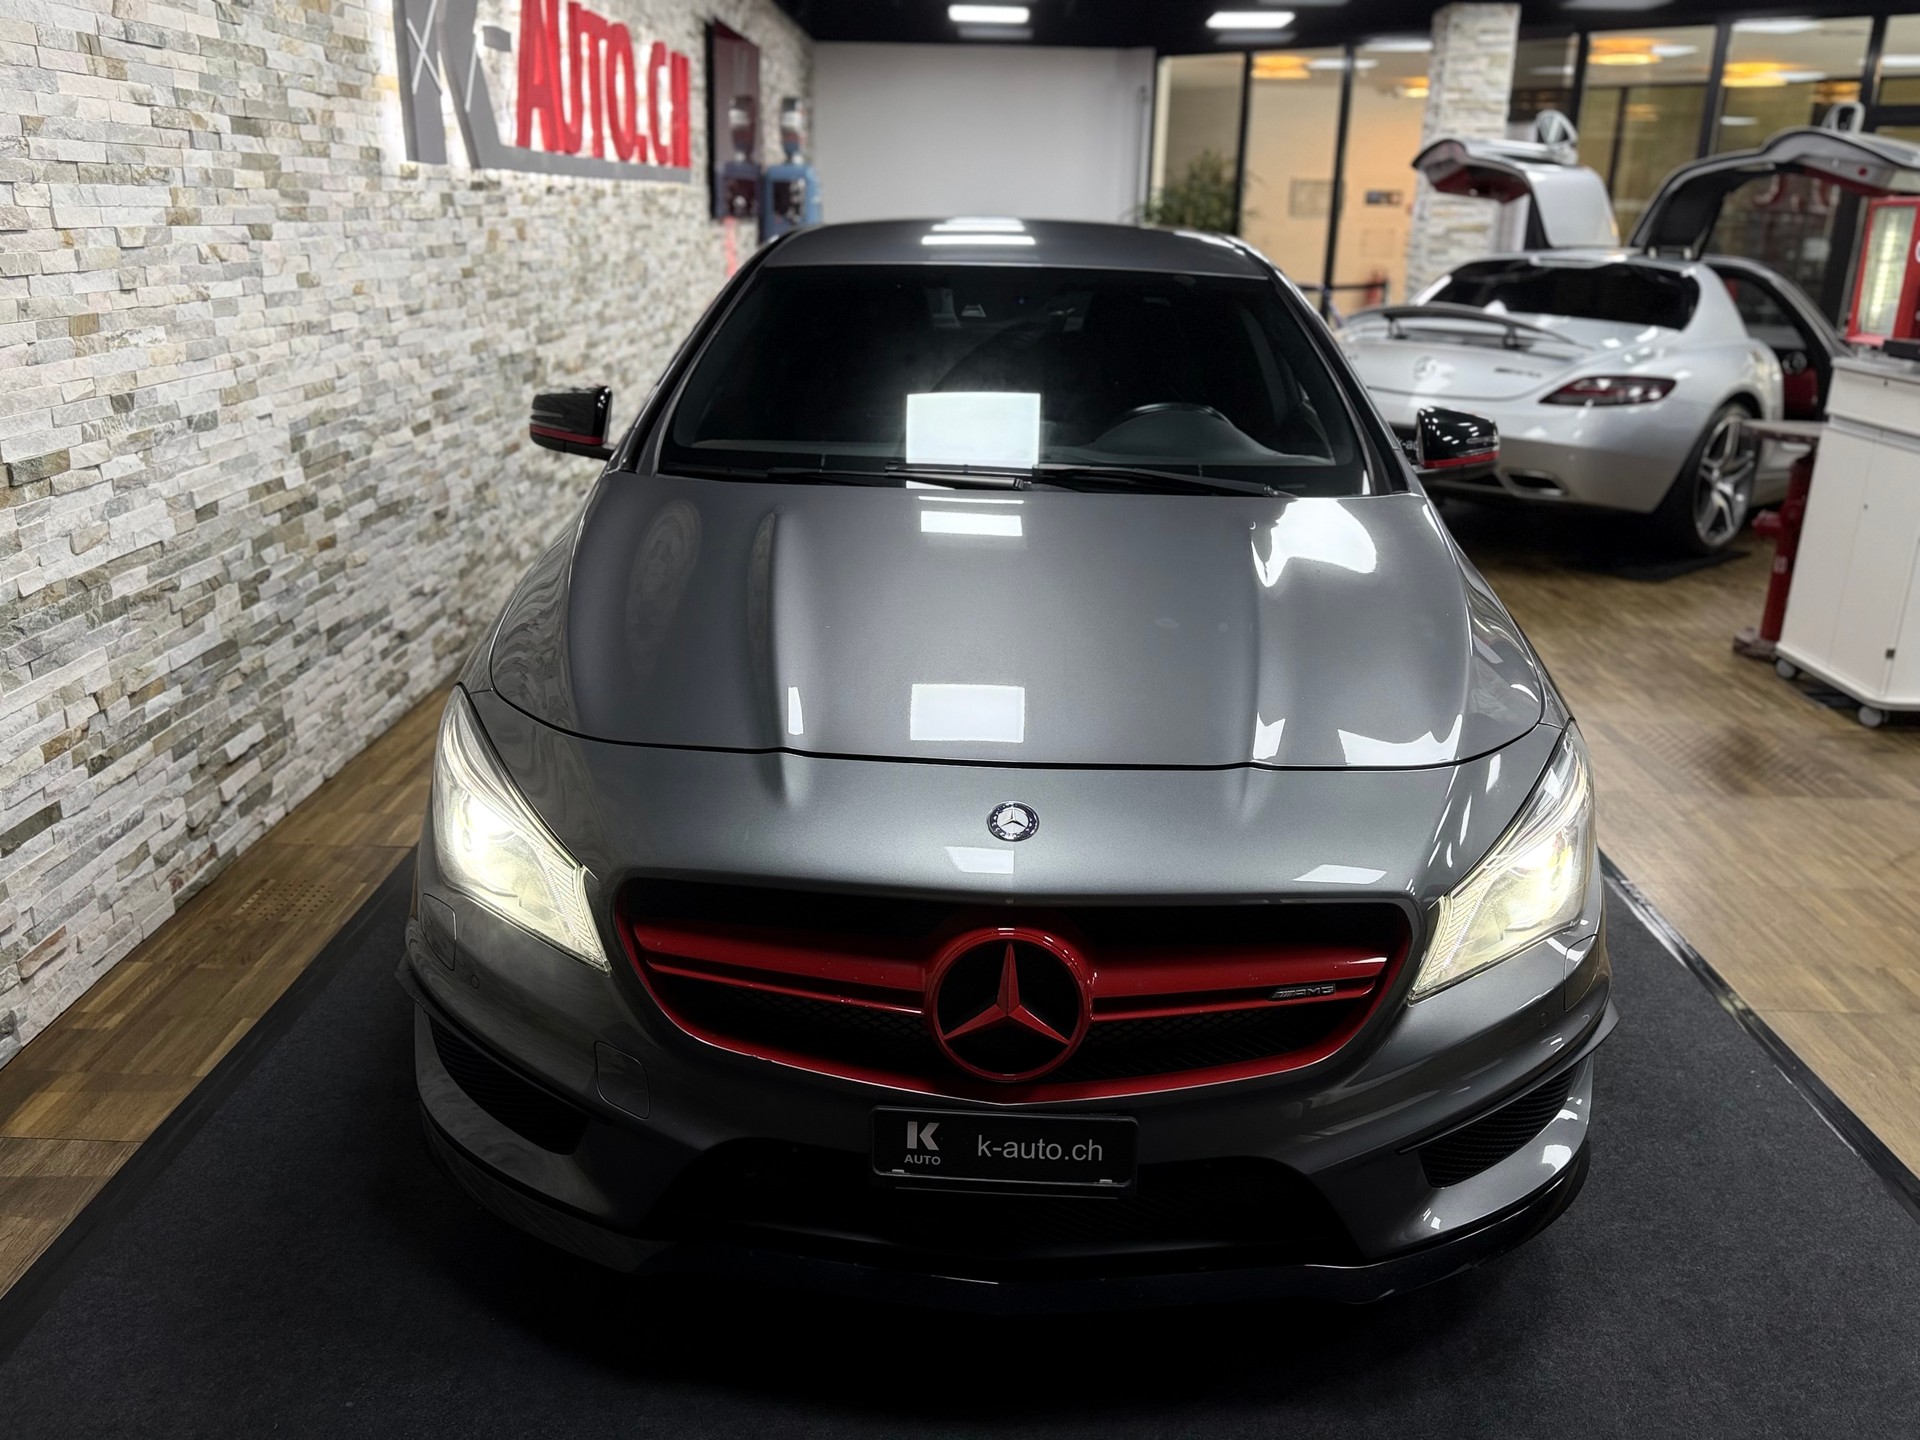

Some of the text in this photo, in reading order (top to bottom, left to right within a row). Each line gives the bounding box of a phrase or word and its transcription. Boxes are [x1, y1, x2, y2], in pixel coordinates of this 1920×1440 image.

[1293, 985, 1334, 996] AMG
[906, 1121, 940, 1151] K
[977, 1134, 1103, 1162] k-auto.ch
[904, 1154, 941, 1166] AUTO
